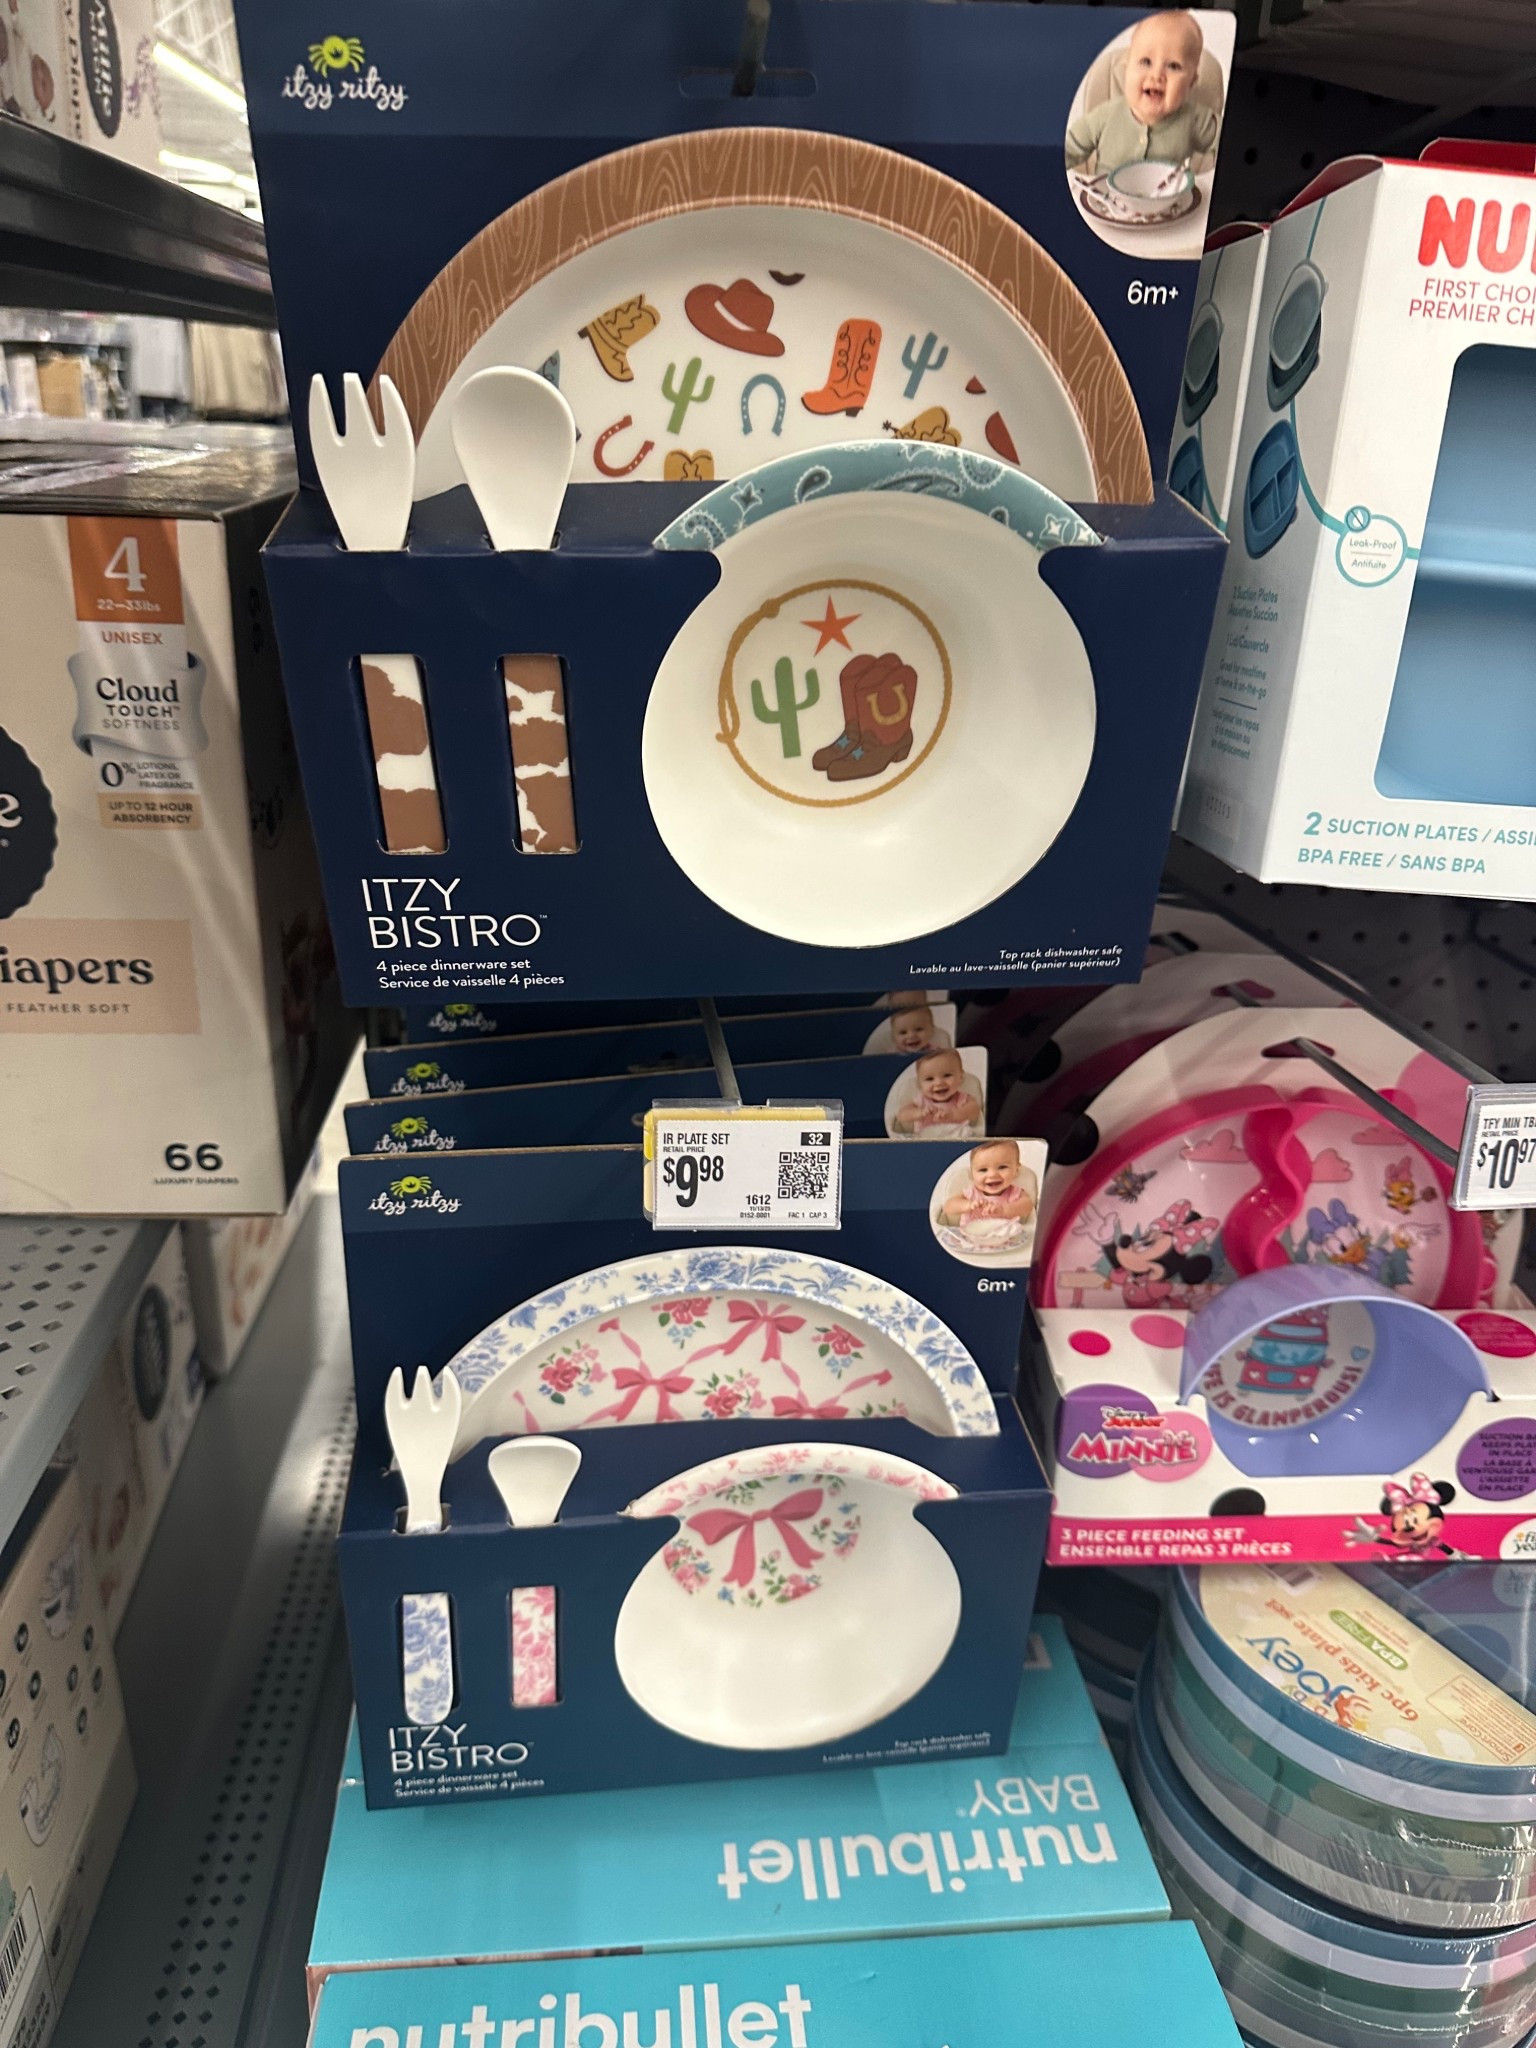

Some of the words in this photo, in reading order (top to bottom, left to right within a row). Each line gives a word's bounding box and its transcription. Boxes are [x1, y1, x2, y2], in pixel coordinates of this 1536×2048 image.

[282, 64, 334, 110] itzy
[339, 65, 409, 111] ritzy
[1418, 194, 1536, 276] NU
[1127, 280, 1179, 305] 6m+
[1424, 278, 1480, 300] FIRST
[1409, 299, 1500, 323] PREMIER
[1350, 537, 1397, 550] Leak-Proof
[104, 537, 147, 592] 4
[1351, 558, 1387, 569] Antifuite
[102, 630, 163, 645] UNISEX
[96, 677, 180, 702] Cloud
[103, 718, 180, 731] SOFTNESS
[109, 801, 125, 811] UP
[125, 801, 142, 811] TO
[144, 802, 157, 811] 12
[159, 803, 193, 812] HOUR
[113, 814, 191, 823] ABSORBENCY
[1303, 811, 1323, 836] 2
[1327, 818, 1409, 838] SUCTION
[1414, 824, 1478, 842] PLATES
[1297, 848, 1334, 864] BPA
[1338, 850, 1383, 867] FREE
[1400, 854, 1447, 871] SANS
[1451, 857, 1486, 874] BPA
[361, 878, 461, 912] ITZY
[1000, 950, 1018, 961] Top
[1020, 948, 1042, 958] rack
[1045, 947, 1099, 958] dishwasher
[1101, 945, 1123, 956] safe
[376, 961, 388, 972] 4
[391, 959, 428, 975] piece
[430, 958, 508, 971] dinnerware
[510, 958, 531, 969] set
[910, 962, 947, 974] Lavable
[949, 965, 962, 973] au
[964, 961, 1029, 972] lave-vaisselle
[1031, 960, 1067, 972] (panier
[1069, 957, 1120, 969] supérieur)
[379, 976, 430, 989] Service
[433, 976, 450, 988] de
[452, 974, 507, 987] vaisselle
[509, 974, 521, 985] 4
[523, 973, 565, 988] pièces
[7, 1003, 81, 1013] FEATHER
[88, 1003, 131, 1014] SOFT
[1483, 1118, 1501, 1129] TFY
[1502, 1117, 1521, 1128] MIN
[374, 1134, 408, 1153] itzy
[411, 1129, 457, 1150] ritzy
[663, 1133, 674, 1145] IR
[677, 1133, 708, 1145] PLATE
[711, 1133, 730, 1145] SET
[808, 1133, 824, 1145] 32
[164, 1143, 223, 1172] 66
[368, 1192, 407, 1216] itzy
[410, 1190, 462, 1213] ritzy
[746, 1194, 771, 1205] 1612
[977, 1278, 1016, 1292] 6m+
[1067, 1431, 1197, 1464] MINNIE
[1062, 1528, 1072, 1540] 3
[1076, 1529, 1127, 1542] PIECE
[1131, 1529, 1209, 1542] FEEDING
[1213, 1528, 1246, 1540] SET
[1059, 1544, 1152, 1558] ENSEMBLE
[1158, 1544, 1214, 1557] REPAS
[1217, 1544, 1229, 1556] 3
[1232, 1539, 1293, 1556] PIÈCES
[1293, 1620, 1343, 1656] plate
[1338, 1656, 1382, 1692] kids
[1380, 1689, 1419, 1721] 6pc
[388, 1723, 468, 1750] ITZY
[393, 1777, 402, 1787] 4
[405, 1776, 436, 1788] piece
[437, 1772, 500, 1784] dinnerware
[502, 1769, 518, 1779] set
[395, 1787, 436, 1797] Service
[438, 1784, 452, 1794] de
[454, 1781, 498, 1793] vaisselle
[718, 1822, 1119, 1901] nutribullet
